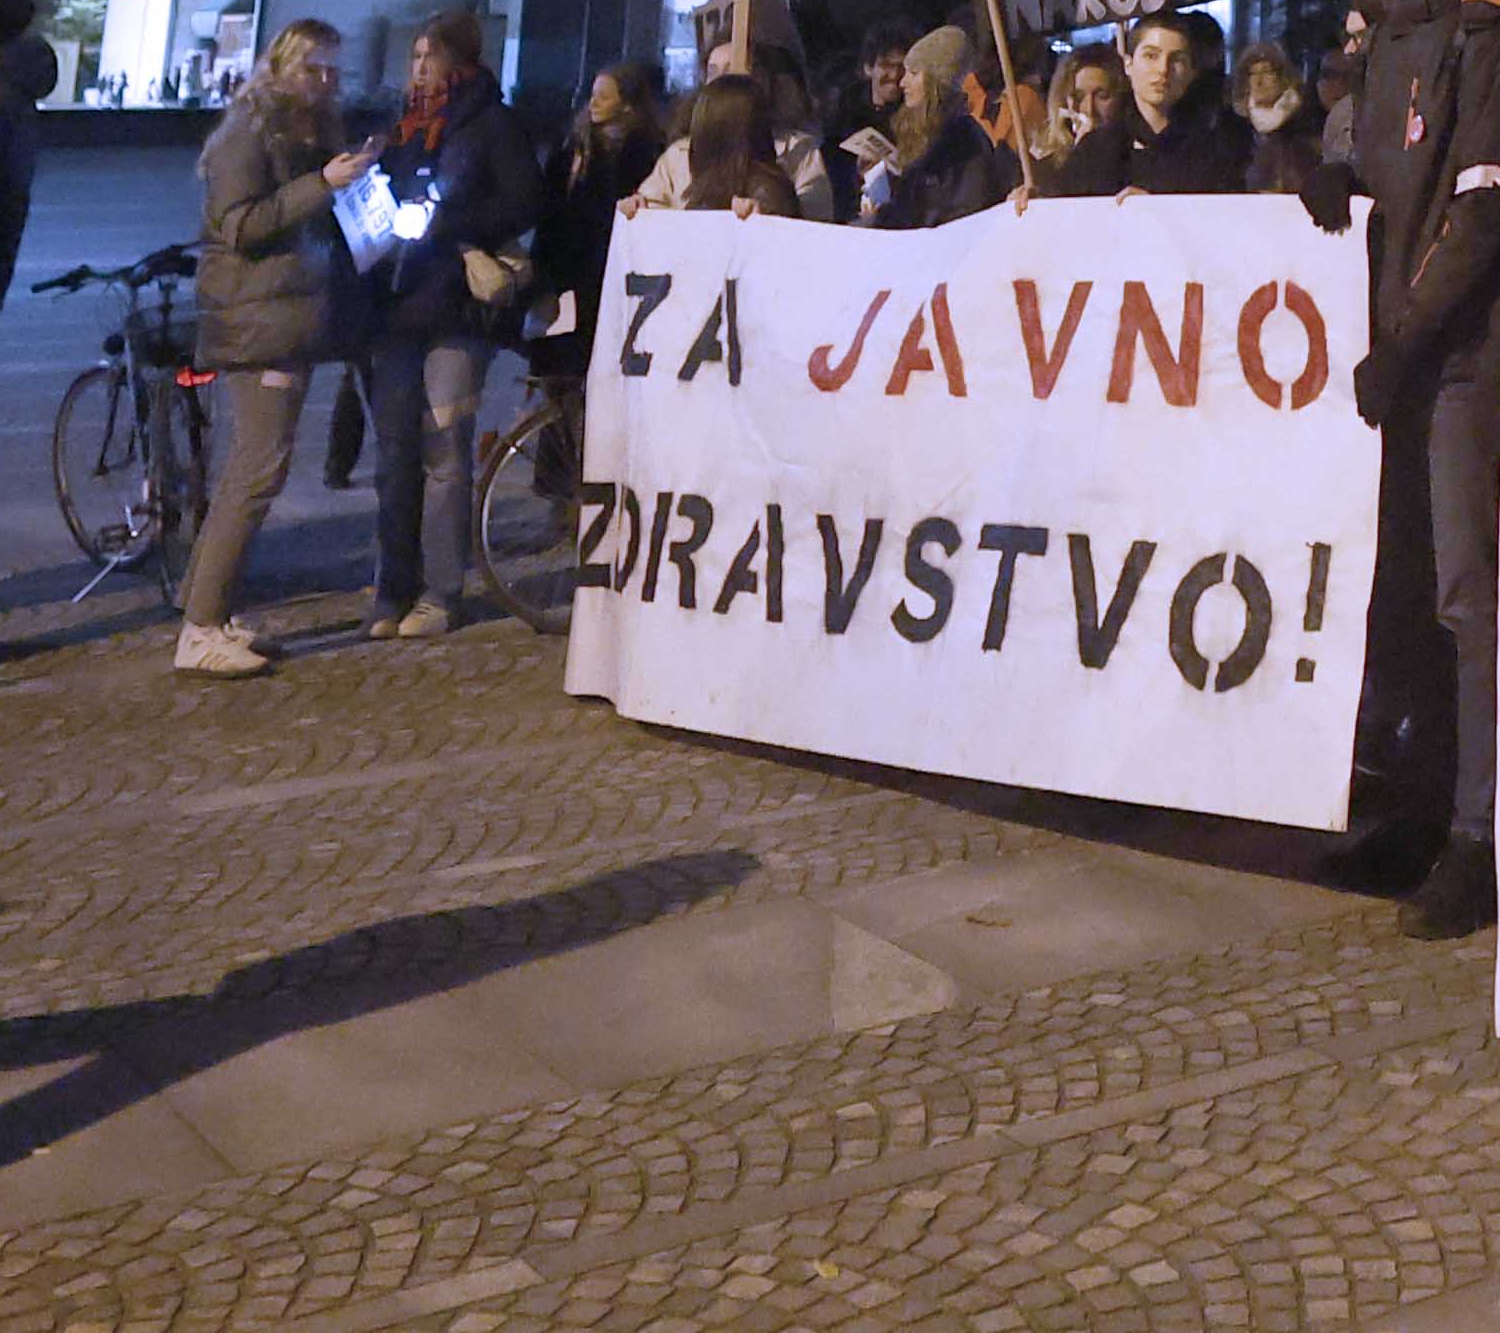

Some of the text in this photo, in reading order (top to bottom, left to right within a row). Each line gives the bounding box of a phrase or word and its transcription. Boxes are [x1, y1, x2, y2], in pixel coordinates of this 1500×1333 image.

[619, 272, 1329, 411] ZA JAVNO
[567, 482, 1332, 695] ZDRAVSTVO!
